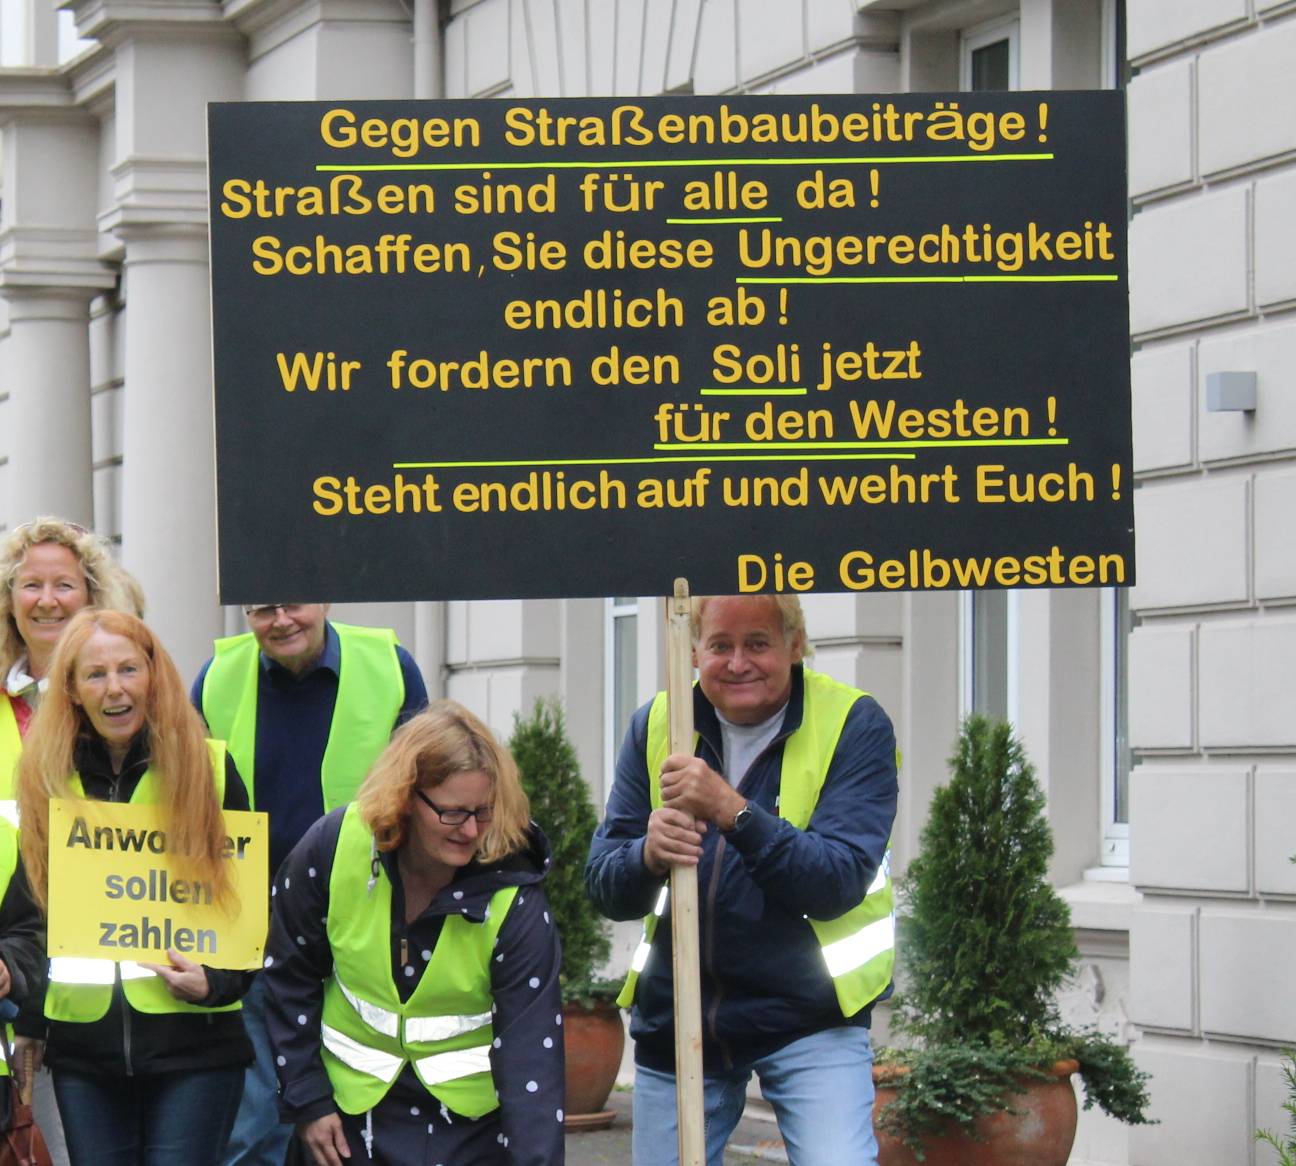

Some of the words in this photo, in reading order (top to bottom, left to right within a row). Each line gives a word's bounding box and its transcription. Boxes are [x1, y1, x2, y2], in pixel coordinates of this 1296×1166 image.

[320, 108, 481, 157] Gegen
[220, 173, 435, 219] Straßen
[454, 173, 556, 215] sind
[579, 172, 665, 213] für
[683, 168, 769, 211] alle
[492, 230, 567, 272] Sie
[583, 229, 714, 271] diese
[737, 220, 1115, 275] Ungerechtigkeit
[504, 287, 684, 331] endlich
[276, 351, 362, 393] Wir
[387, 349, 572, 392] fordern
[590, 345, 680, 387] den
[712, 343, 799, 384] Soli
[816, 340, 923, 391] jetzt
[654, 402, 731, 443] für
[745, 401, 834, 442] den
[312, 473, 443, 516] Steht
[452, 469, 627, 513] endlich
[636, 467, 710, 509] auf
[722, 466, 811, 508] und
[818, 464, 961, 506] wehrt
[737, 552, 815, 593] Die
[839, 546, 1125, 591] Gelbwesten
[66, 815, 252, 860] Anwoer
[105, 868, 213, 905] sollen
[98, 916, 217, 954] zahlen
